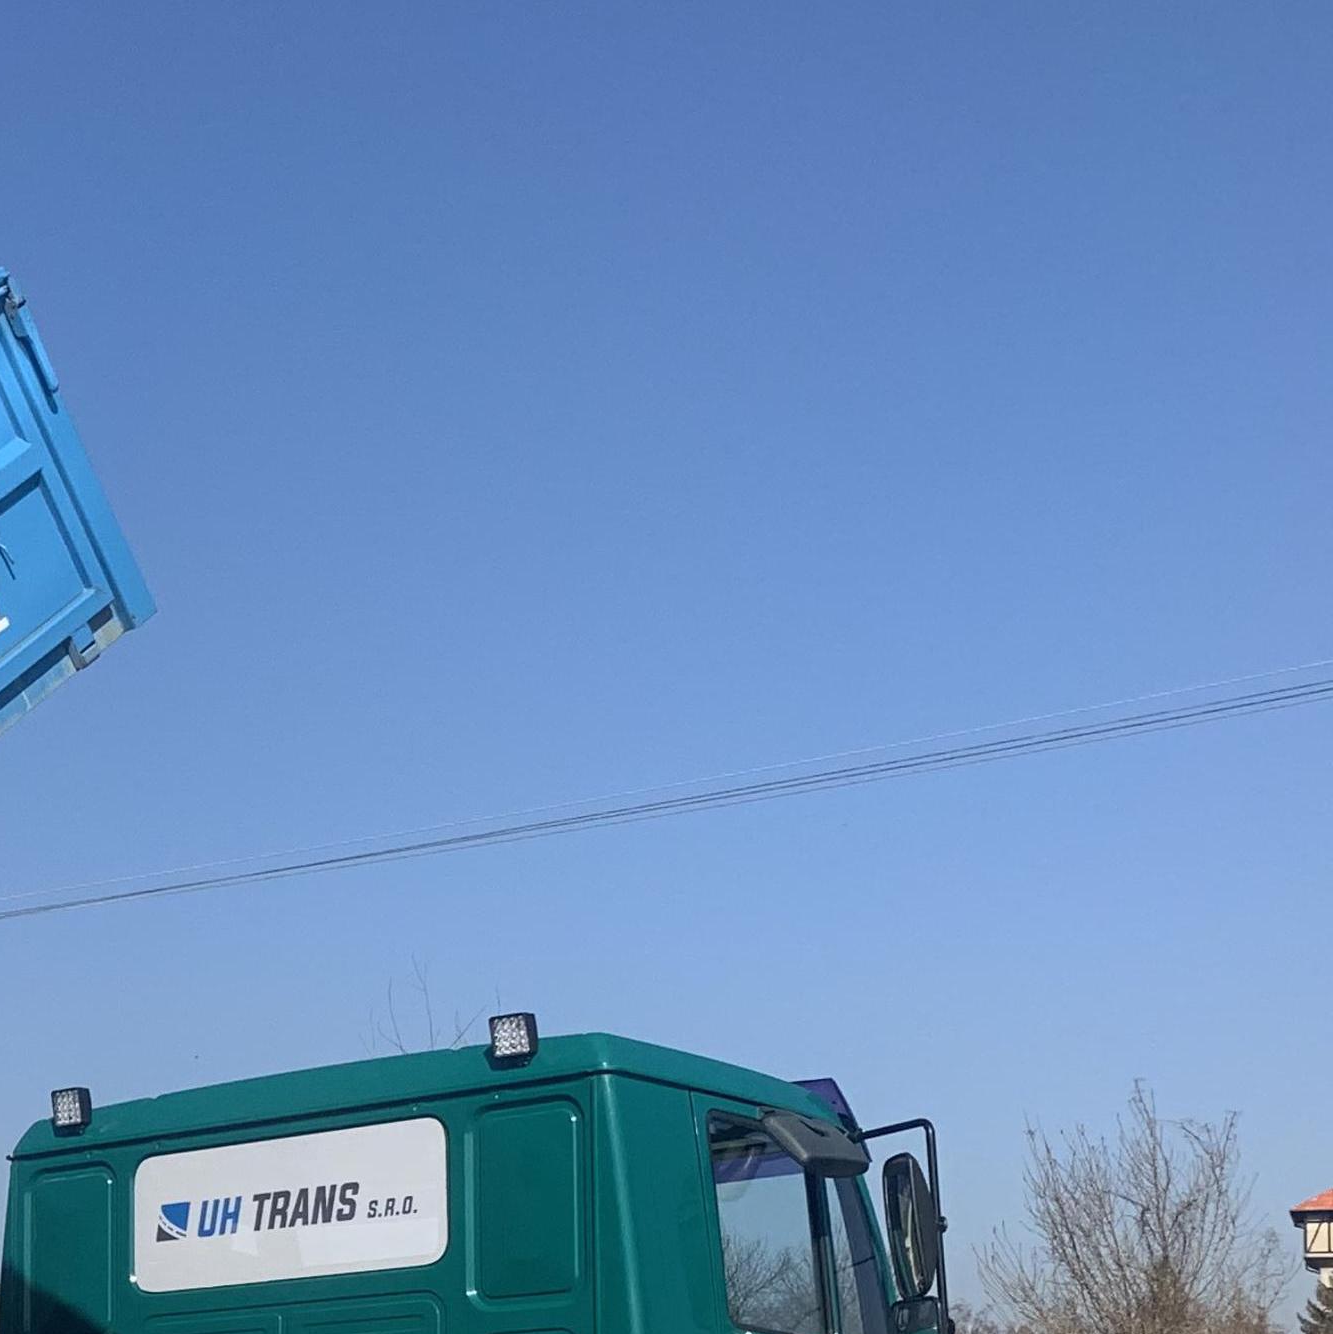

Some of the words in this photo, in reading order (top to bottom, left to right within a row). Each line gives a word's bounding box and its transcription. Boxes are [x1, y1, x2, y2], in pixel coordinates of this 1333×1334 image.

[197, 1196, 242, 1239] UH
[252, 1181, 360, 1232] TRANS
[367, 1195, 419, 1219] S.R.O.
